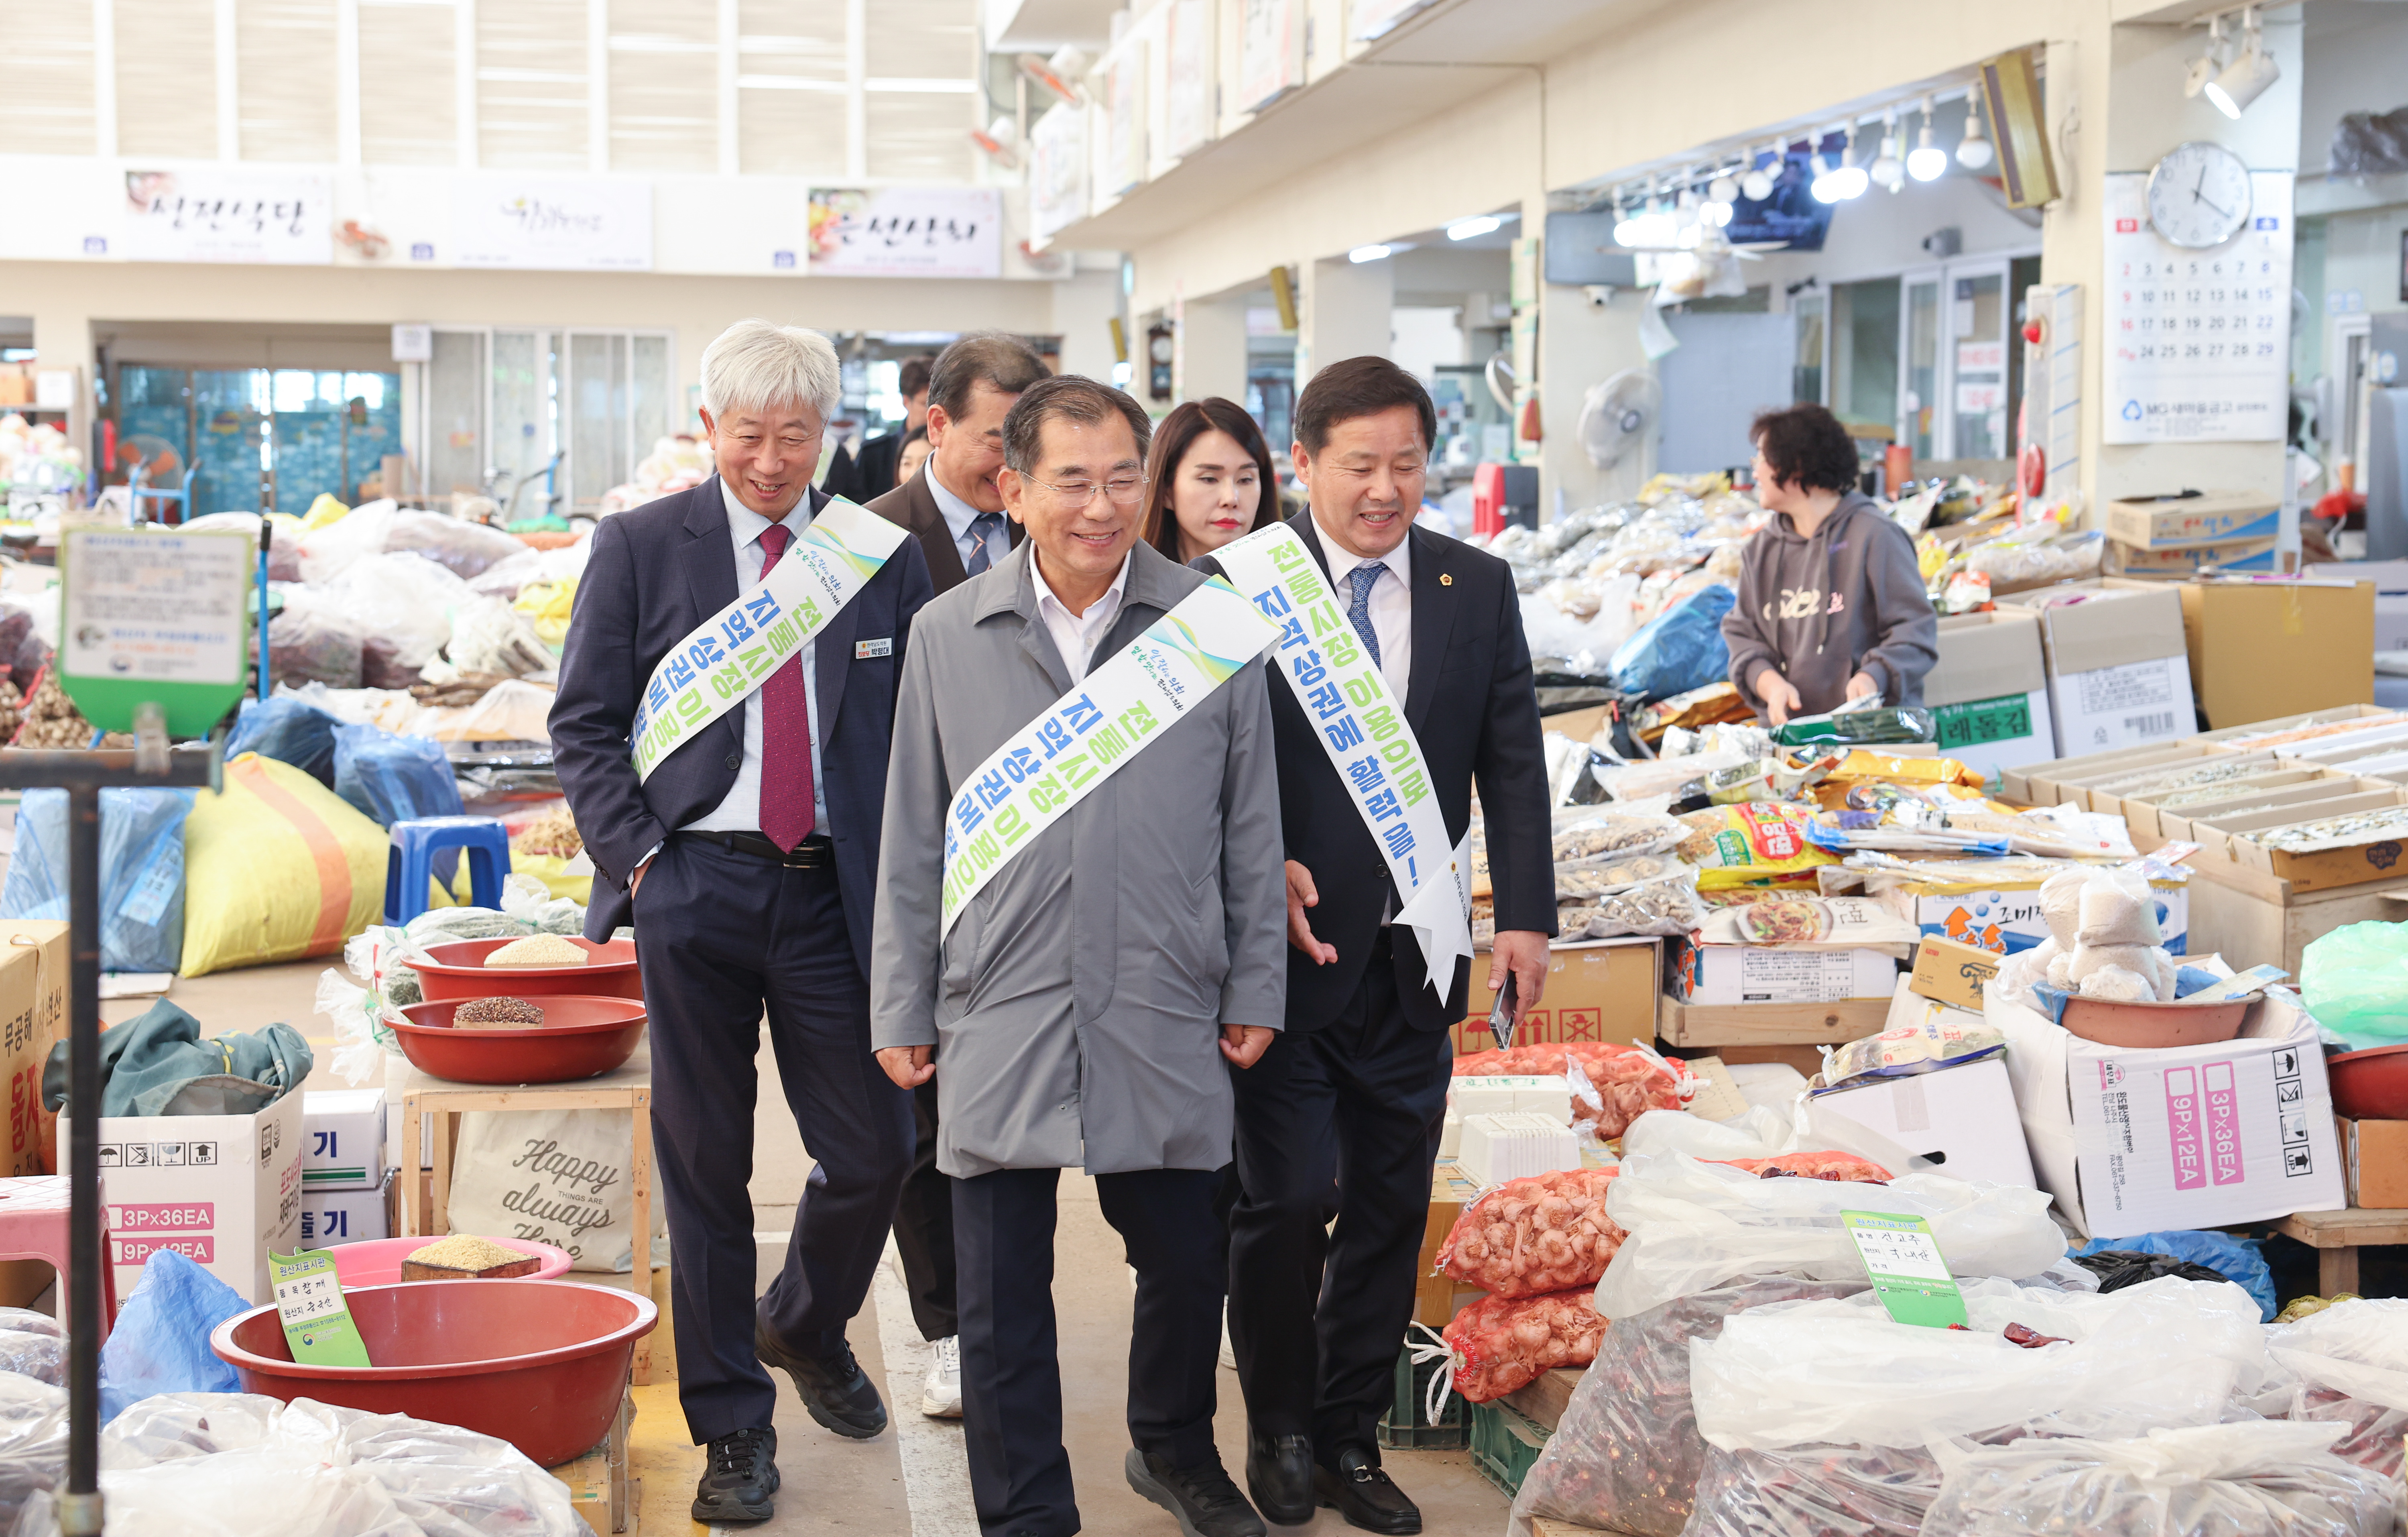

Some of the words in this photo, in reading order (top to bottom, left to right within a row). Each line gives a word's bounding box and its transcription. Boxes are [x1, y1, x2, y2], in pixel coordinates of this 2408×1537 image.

[820, 576, 840, 606] 전라남도의회
[829, 575, 842, 591] 의회
[648, 588, 781, 715] 지역상권에
[711, 595, 824, 699] 전통시장
[871, 646, 889, 656] 박형대
[1168, 677, 1185, 695] 의회
[1266, 540, 1360, 668] 전통시장
[1343, 672, 1429, 808] 이용으로
[1157, 678, 1184, 711] 전라남도의회
[1253, 585, 1364, 753] 지역상권에
[1346, 754, 1419, 888] 활력을!
[956, 693, 1104, 835] 지역상권에
[1027, 699, 1159, 814] 전통시장
[1761, 822, 1795, 856] 당면
[944, 803, 1031, 918] 이용으로
[5, 1007, 33, 1058] 무공해
[2105, 1064, 2115, 1085] 새우표
[2172, 1098, 2199, 1184] 9Px12EA
[2211, 1091, 2239, 1182] 3Px36EA
[513, 1138, 619, 1194] Happy
[2286, 1154, 2296, 1171] UP
[502, 1183, 616, 1237] always
[558, 1190, 586, 1203] THINGS
[588, 1197, 604, 1205] ARE
[124, 1209, 210, 1227] 3Px36EA
[1855, 1218, 1918, 1230] 원산지표시판
[280, 1257, 325, 1277] 원산지표시판
[285, 1306, 304, 1319] 원산지
